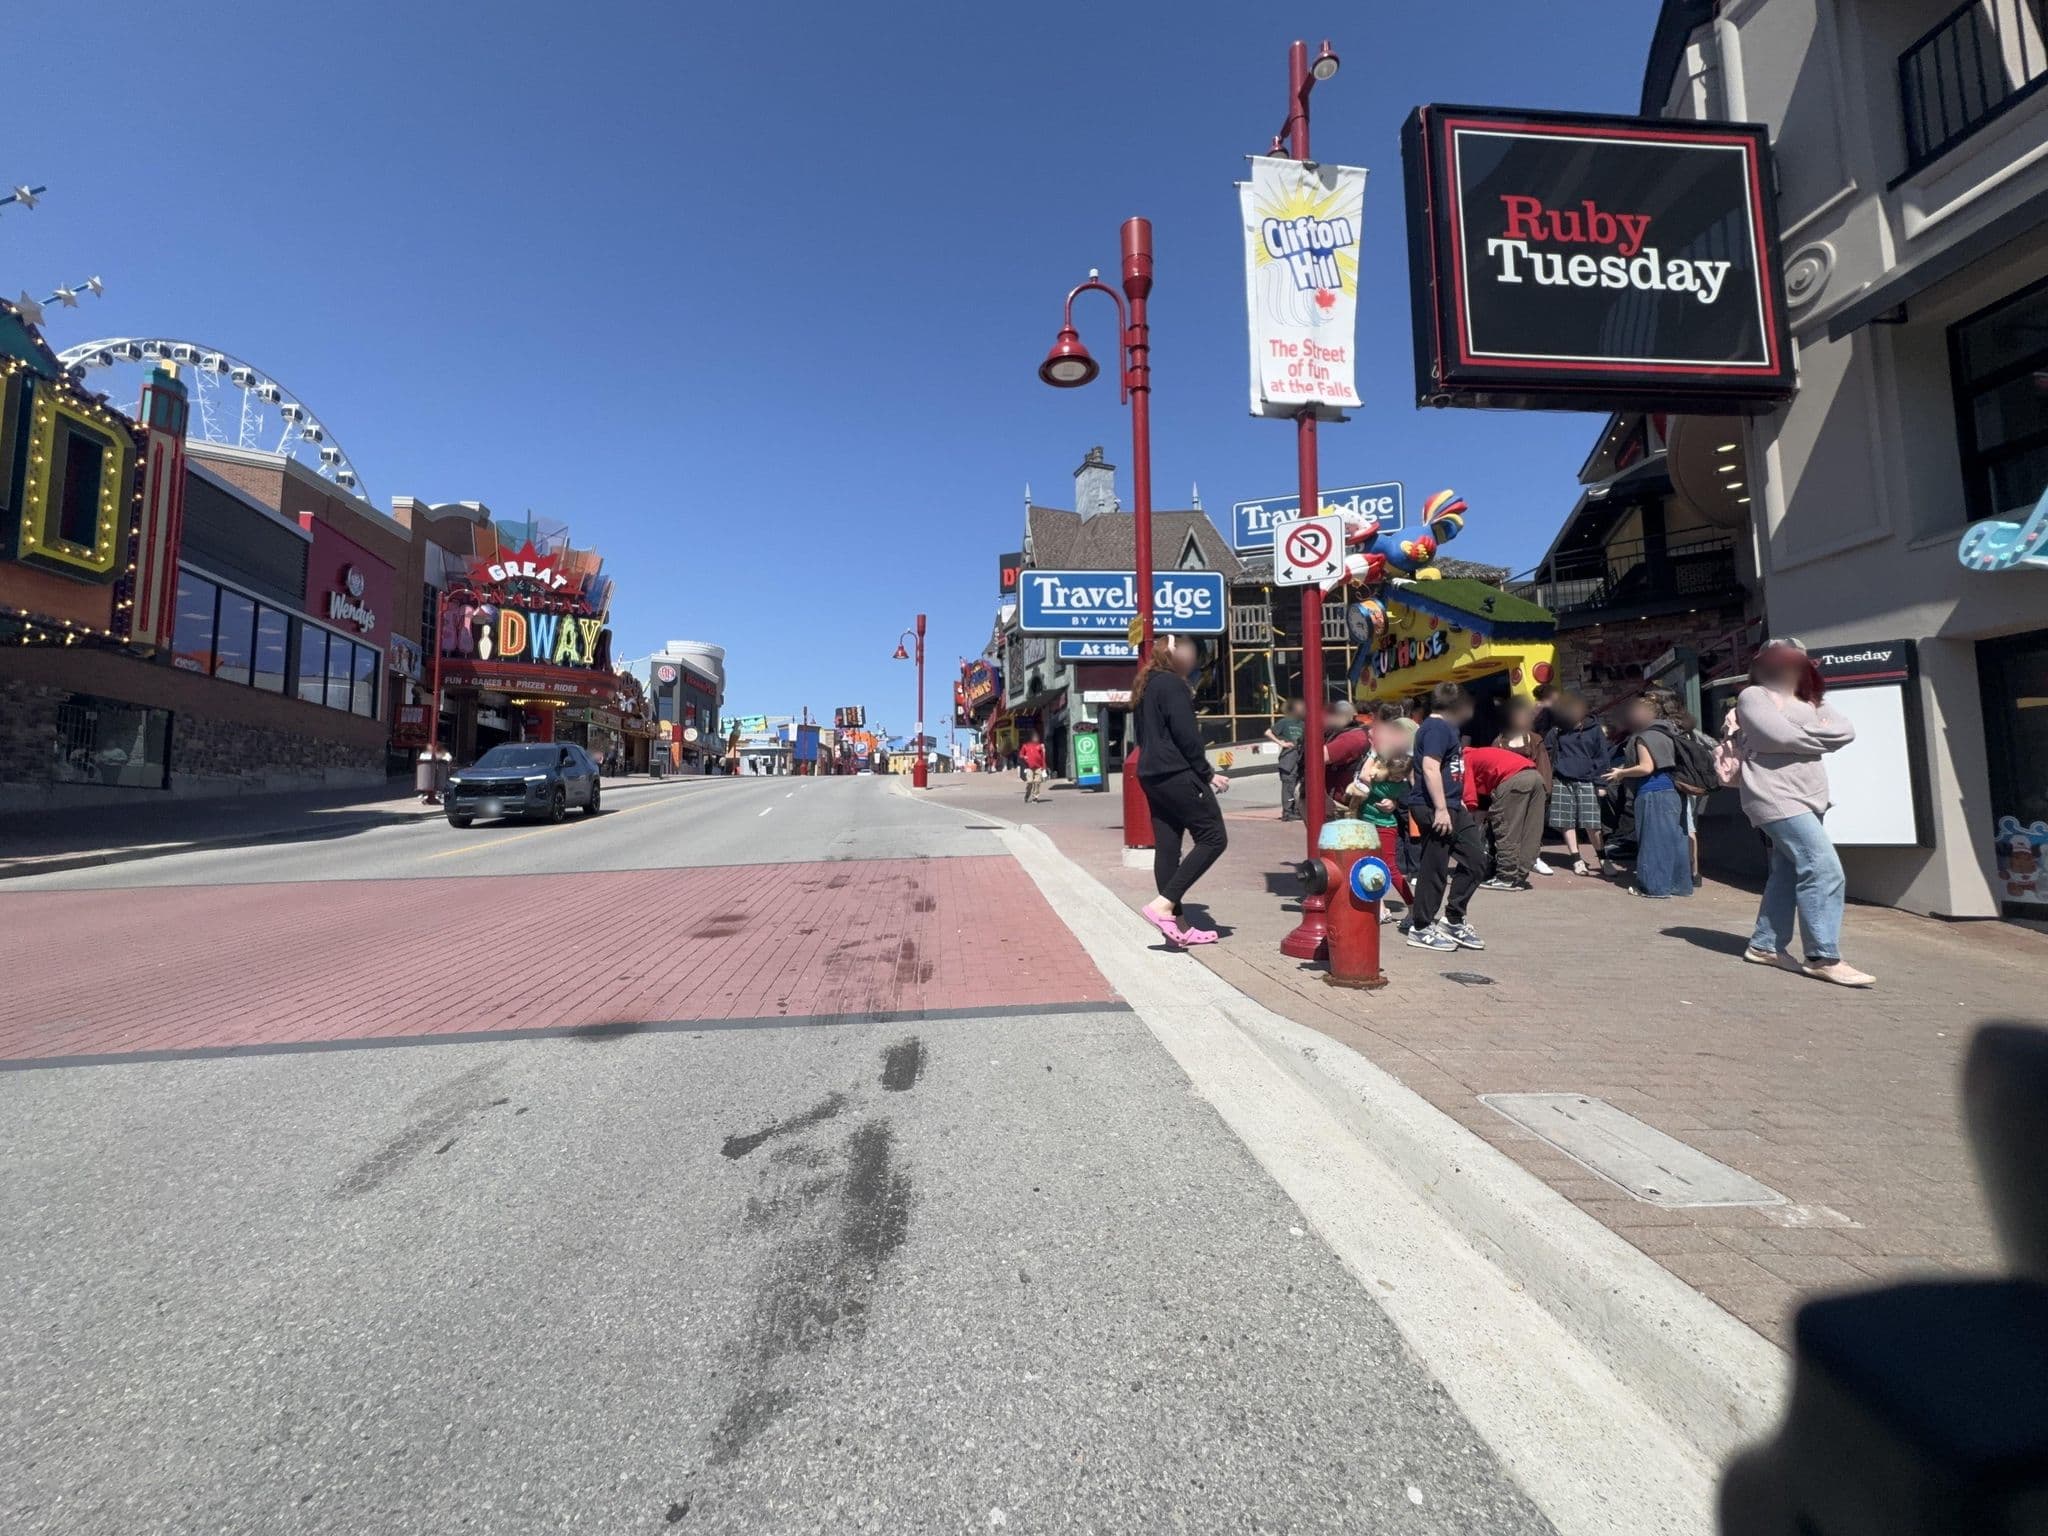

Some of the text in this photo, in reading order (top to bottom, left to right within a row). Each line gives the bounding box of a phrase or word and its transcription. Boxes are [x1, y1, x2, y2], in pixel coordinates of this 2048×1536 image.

[1262, 215, 1354, 259] Clifton
[1500, 194, 1652, 257] Ruby
[1287, 250, 1342, 291] Hill
[1487, 238, 1732, 304] Tuesday
[1269, 338, 1346, 363] The Street
[1288, 359, 1329, 380] of fun
[1270, 378, 1352, 398] at the Falls
[487, 561, 568, 590] GREAT
[330, 590, 375, 632] Wendy's
[1033, 576, 1212, 618] Traveldge
[1071, 617, 1172, 626] BY WYNAM
[1080, 643, 1099, 656] At
[1103, 643, 1128, 656] the
[1398, 631, 1442, 667] HOUSE
[1822, 651, 1893, 665] Tuesday
[444, 676, 462, 685] FUN
[471, 678, 502, 687] GAMES
[516, 680, 545, 689] PRIZES
[553, 684, 578, 693] RIDES
